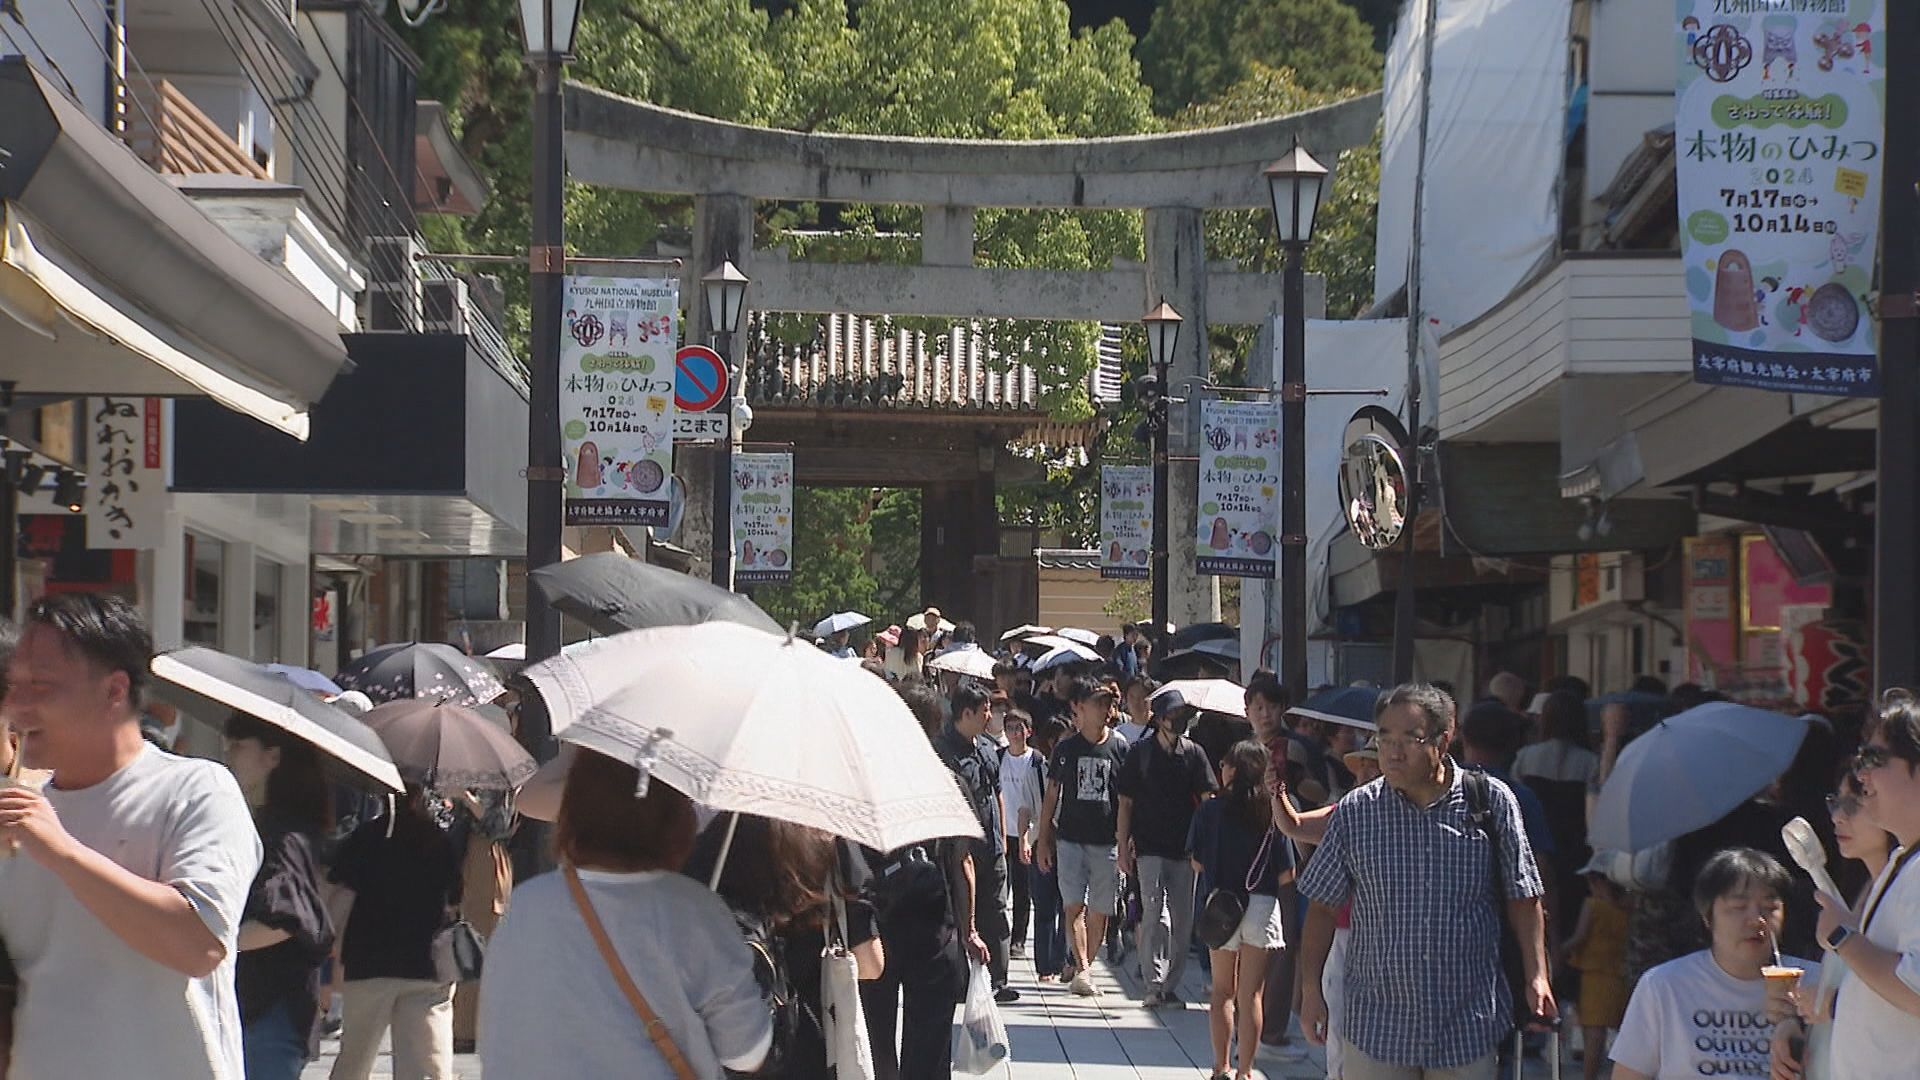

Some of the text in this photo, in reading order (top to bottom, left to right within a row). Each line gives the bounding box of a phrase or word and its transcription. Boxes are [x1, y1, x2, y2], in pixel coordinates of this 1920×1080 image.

[1685, 130, 1877, 162] 本物のひみつ
[600, 288, 639, 296] NATIONAL
[641, 289, 672, 297] MUSEUM
[565, 373, 672, 393] 本物のひみつ
[96, 397, 139, 540] ぬれおかき
